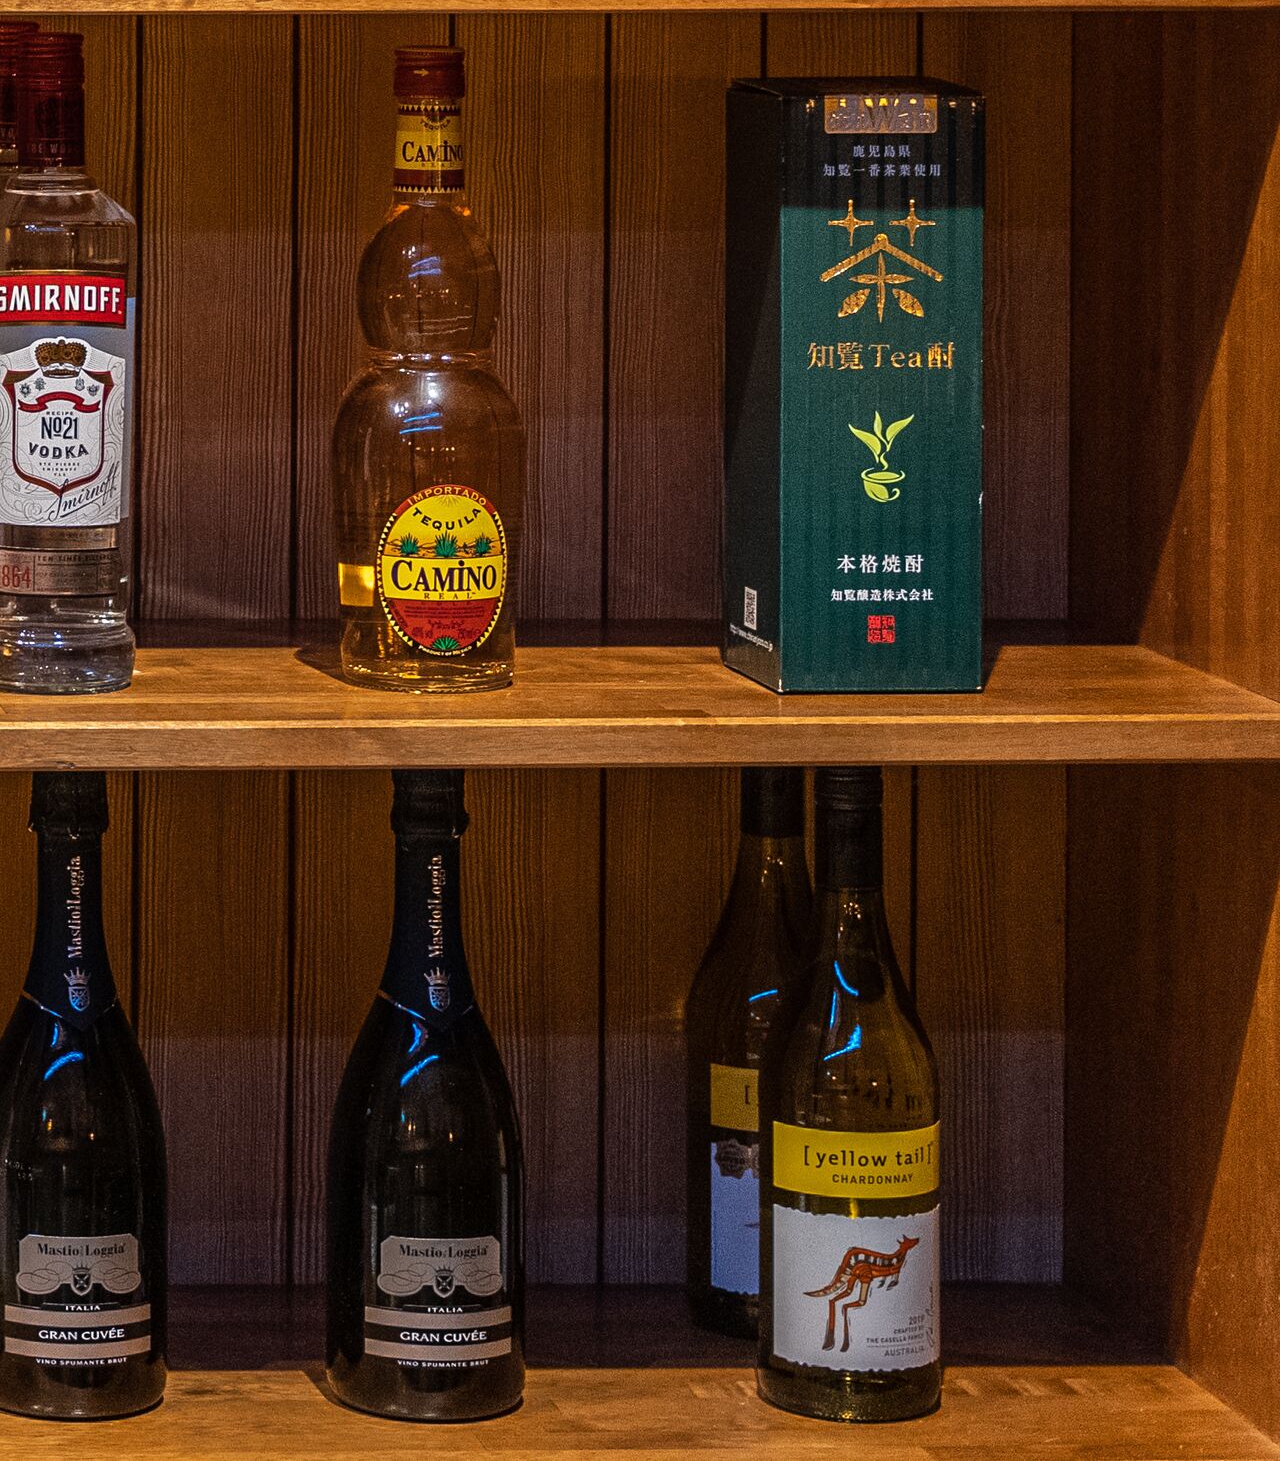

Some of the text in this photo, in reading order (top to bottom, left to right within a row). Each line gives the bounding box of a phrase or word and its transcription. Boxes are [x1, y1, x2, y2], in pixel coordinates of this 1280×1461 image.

[28, 442, 89, 459] VODKA
[407, 486, 487, 506] IMPORTADO
[412, 507, 482, 530] TEQUILA
[837, 554, 925, 574] 本格焼酎
[831, 589, 934, 602] 知覧醸造株式会社
[832, 1173, 913, 1185] CHARDONNAY
[37, 1243, 124, 1258] Mastio Loggia
[399, 1244, 487, 1259] Mastio Loggia
[38, 1327, 125, 1341] GRAN CUVÉE
[400, 1329, 487, 1343] GRAN CUVÉE
